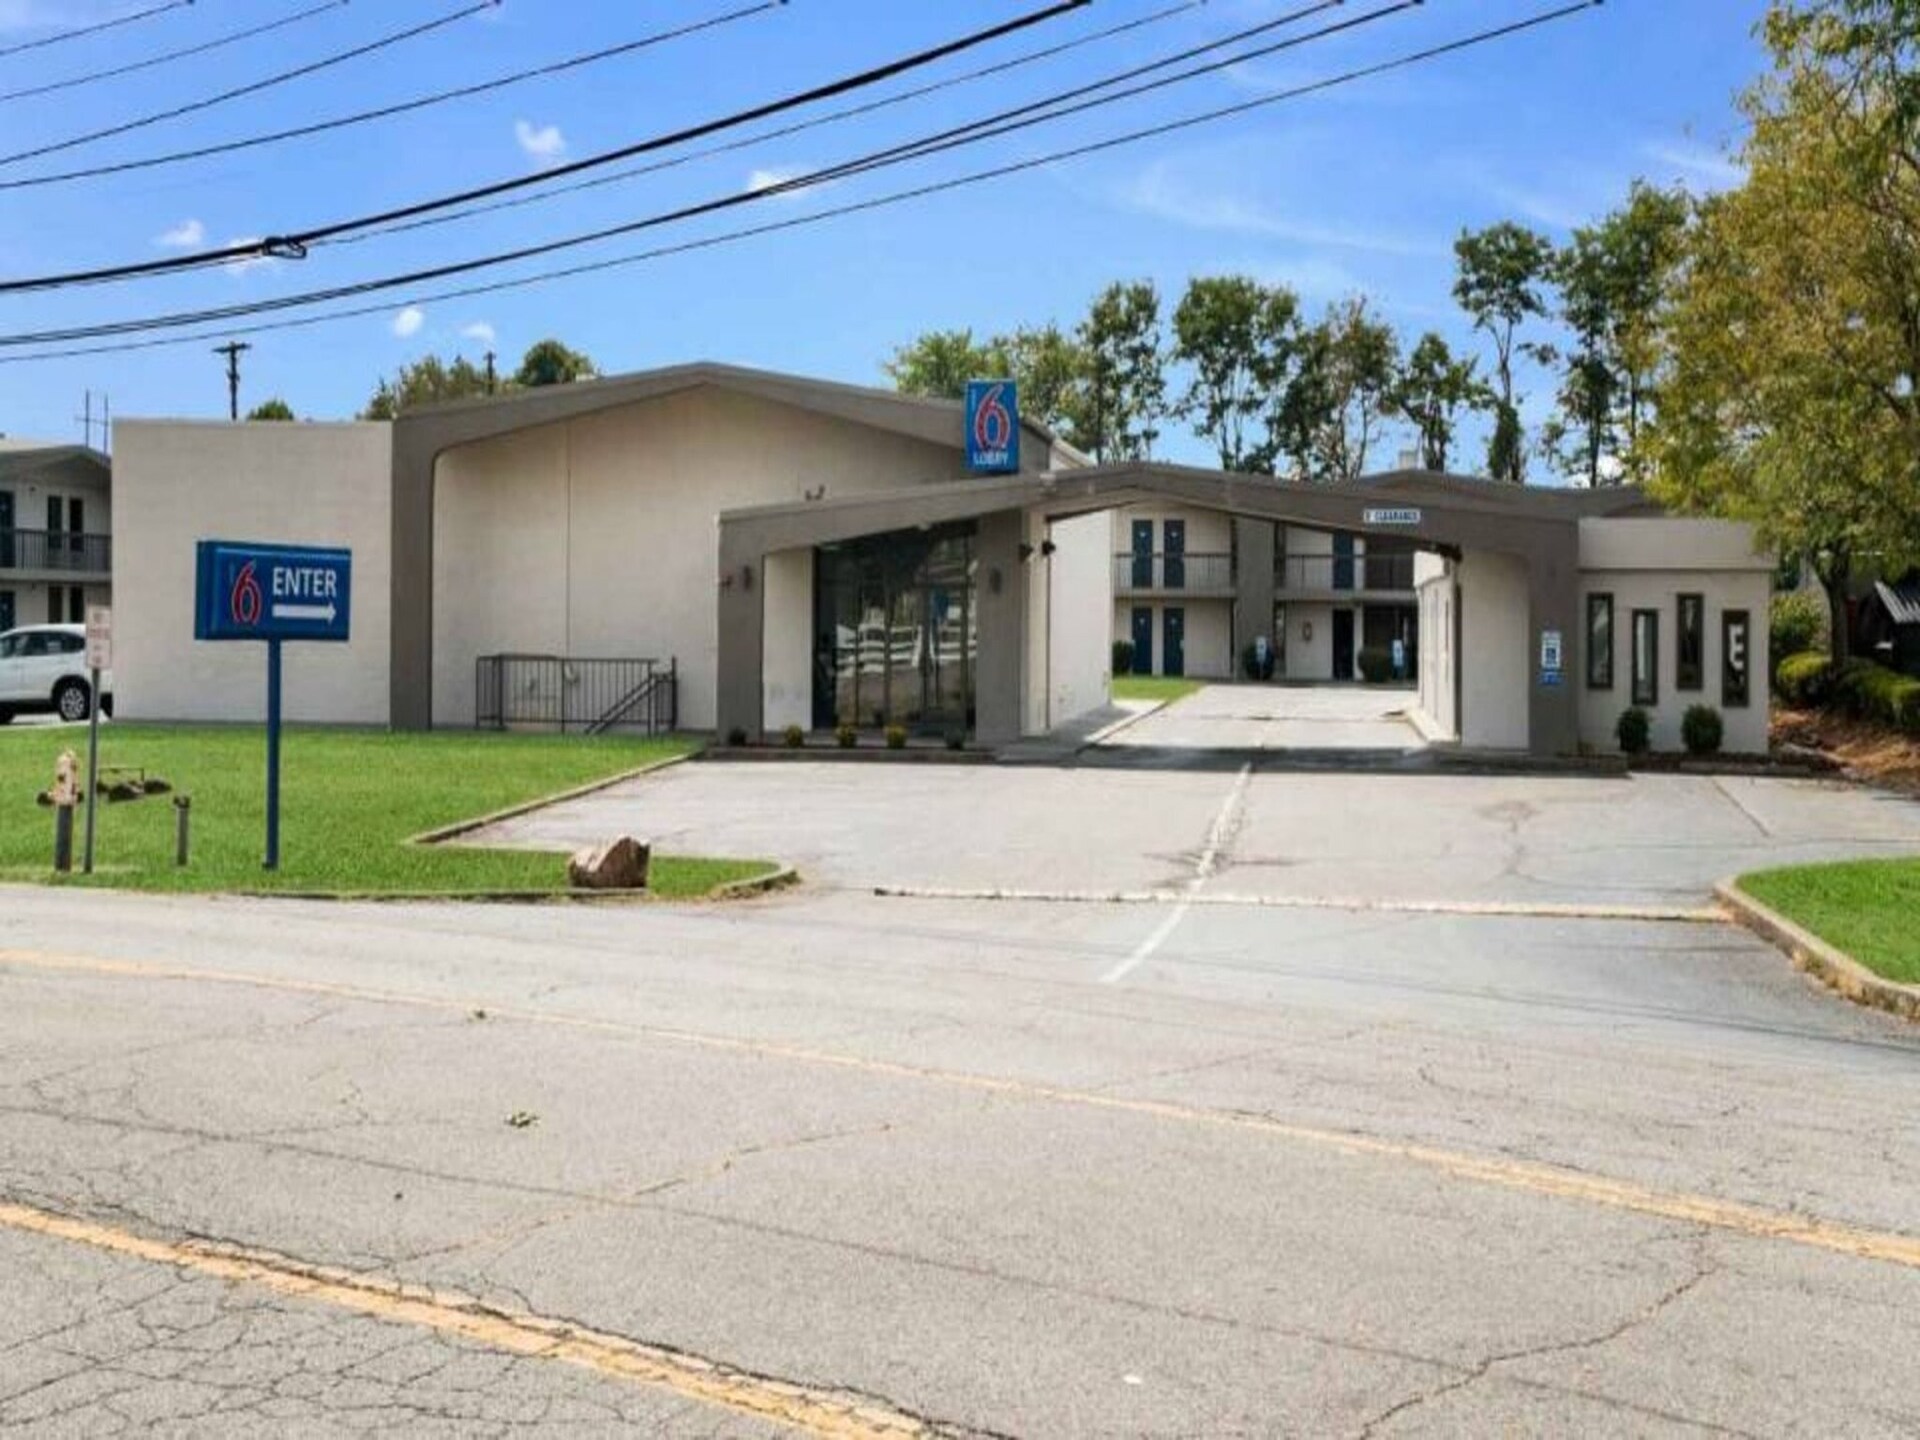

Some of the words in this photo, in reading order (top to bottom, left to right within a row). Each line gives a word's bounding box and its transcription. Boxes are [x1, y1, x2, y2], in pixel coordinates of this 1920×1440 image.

[975, 383, 1010, 450] 6
[231, 560, 261, 625] 6
[272, 566, 337, 598] ENTER
